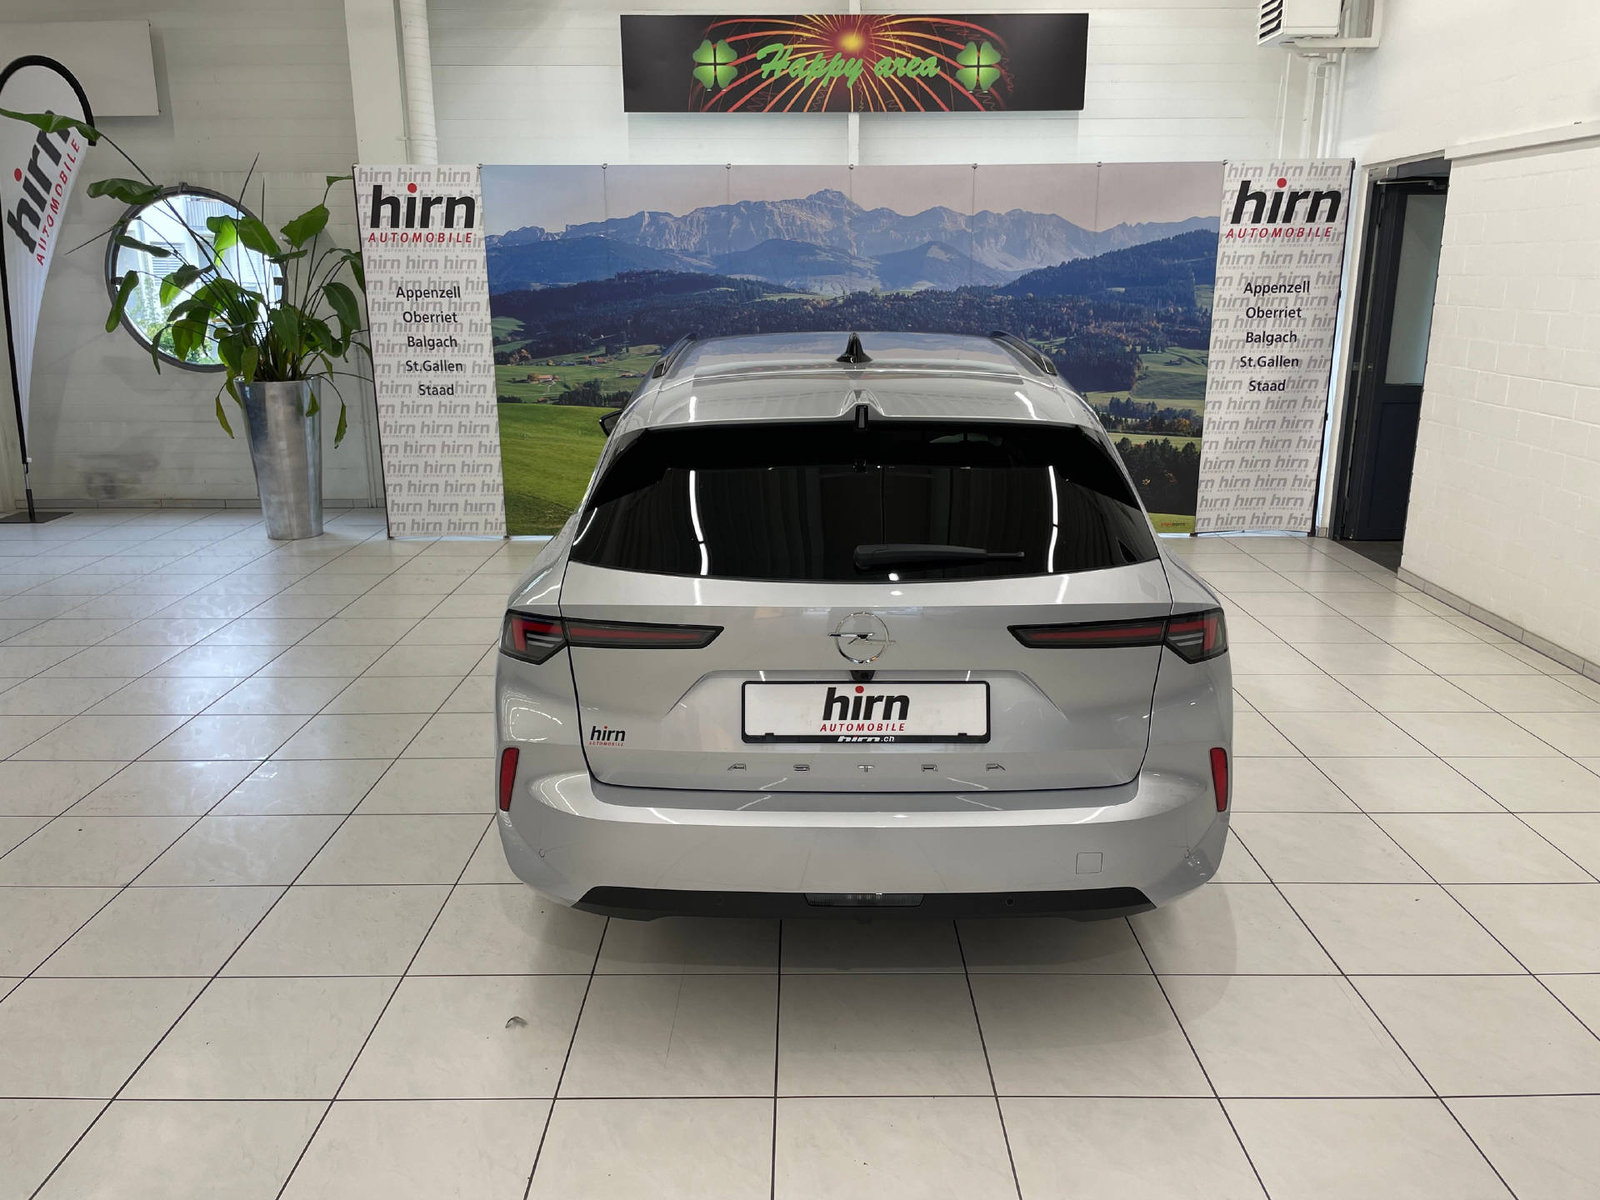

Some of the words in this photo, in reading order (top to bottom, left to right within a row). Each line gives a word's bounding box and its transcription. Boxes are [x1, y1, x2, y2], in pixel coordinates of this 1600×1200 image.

[757, 43, 864, 88] Happy
[874, 55, 940, 78] area
[358, 168, 392, 182] hirn
[397, 168, 431, 182] hirn
[438, 168, 470, 182] hirn
[1228, 163, 1263, 178] hirn
[1268, 162, 1303, 177] hirn
[1308, 162, 1342, 176] hirn
[370, 183, 475, 228] hirn
[1230, 178, 1342, 224] hirn
[368, 232, 472, 242] AUTOMOBILE
[1226, 227, 1333, 238] AUTOMOBILE
[368, 255, 400, 269] hirn
[406, 255, 438, 269] hirn
[444, 255, 477, 269] hirn
[1220, 252, 1254, 264] hirn
[1260, 251, 1293, 264] hirn
[1298, 250, 1332, 264] hirn
[396, 286, 460, 301] Appenzell
[1244, 281, 1310, 296] Appenzell
[371, 298, 404, 312] hirn
[410, 298, 442, 312] hirn
[448, 298, 480, 312] hirn
[1216, 294, 1250, 307] hirn
[1255, 294, 1288, 307] hirn
[1293, 294, 1328, 307] hirn
[402, 311, 458, 322] Oberriet
[1246, 306, 1302, 319] Oberriet
[407, 336, 458, 350] Balgach
[1213, 336, 1246, 349] hirn
[1246, 331, 1297, 346] Balgach
[376, 340, 408, 353] hirn
[406, 360, 463, 372] St.Gallen
[1240, 355, 1299, 368] St.Gallen
[380, 380, 412, 394] hirn
[455, 380, 486, 394] hirn
[1210, 377, 1242, 390] hirn
[1286, 376, 1319, 389] hirn
[1249, 379, 1286, 392] Staad
[418, 384, 454, 396] Staad
[400, 401, 433, 414] hirn
[438, 401, 470, 414] hirn
[1227, 397, 1260, 410] hirn
[1264, 396, 1297, 409] hirn
[383, 421, 415, 434] hirn
[421, 421, 453, 434] hirn
[458, 421, 489, 434] hirn
[1207, 417, 1239, 430] hirn
[1244, 417, 1276, 430] hirn
[1280, 416, 1313, 429] hirn
[404, 441, 436, 454] hirn
[441, 441, 473, 454] hirn
[1223, 437, 1256, 450] hirn
[1260, 437, 1292, 449] hirn
[387, 461, 418, 473] hirn
[424, 461, 456, 473] hirn
[461, 461, 493, 473] hirn
[1203, 457, 1235, 469] hirn
[1239, 456, 1271, 468] hirn
[1275, 456, 1309, 468] hirn
[408, 480, 439, 493] hirn
[444, 480, 476, 493] hirn
[1219, 476, 1250, 489] hirn
[1255, 475, 1287, 487] hirn
[391, 500, 422, 512] hirn
[428, 500, 459, 512] hirn
[464, 500, 495, 512] hirn
[1200, 496, 1230, 507] hirn
[1234, 495, 1266, 507] hirn
[1270, 494, 1304, 506] hirn
[411, 519, 442, 531] hirn
[447, 519, 479, 531] hirn
[1215, 514, 1246, 526] hirn
[1250, 513, 1283, 525] hirn
[822, 686, 910, 720] hirn
[590, 725, 626, 742] hirn
[820, 723, 905, 732] AUTOMOBILE
[727, 763, 1005, 772] ASTRA
